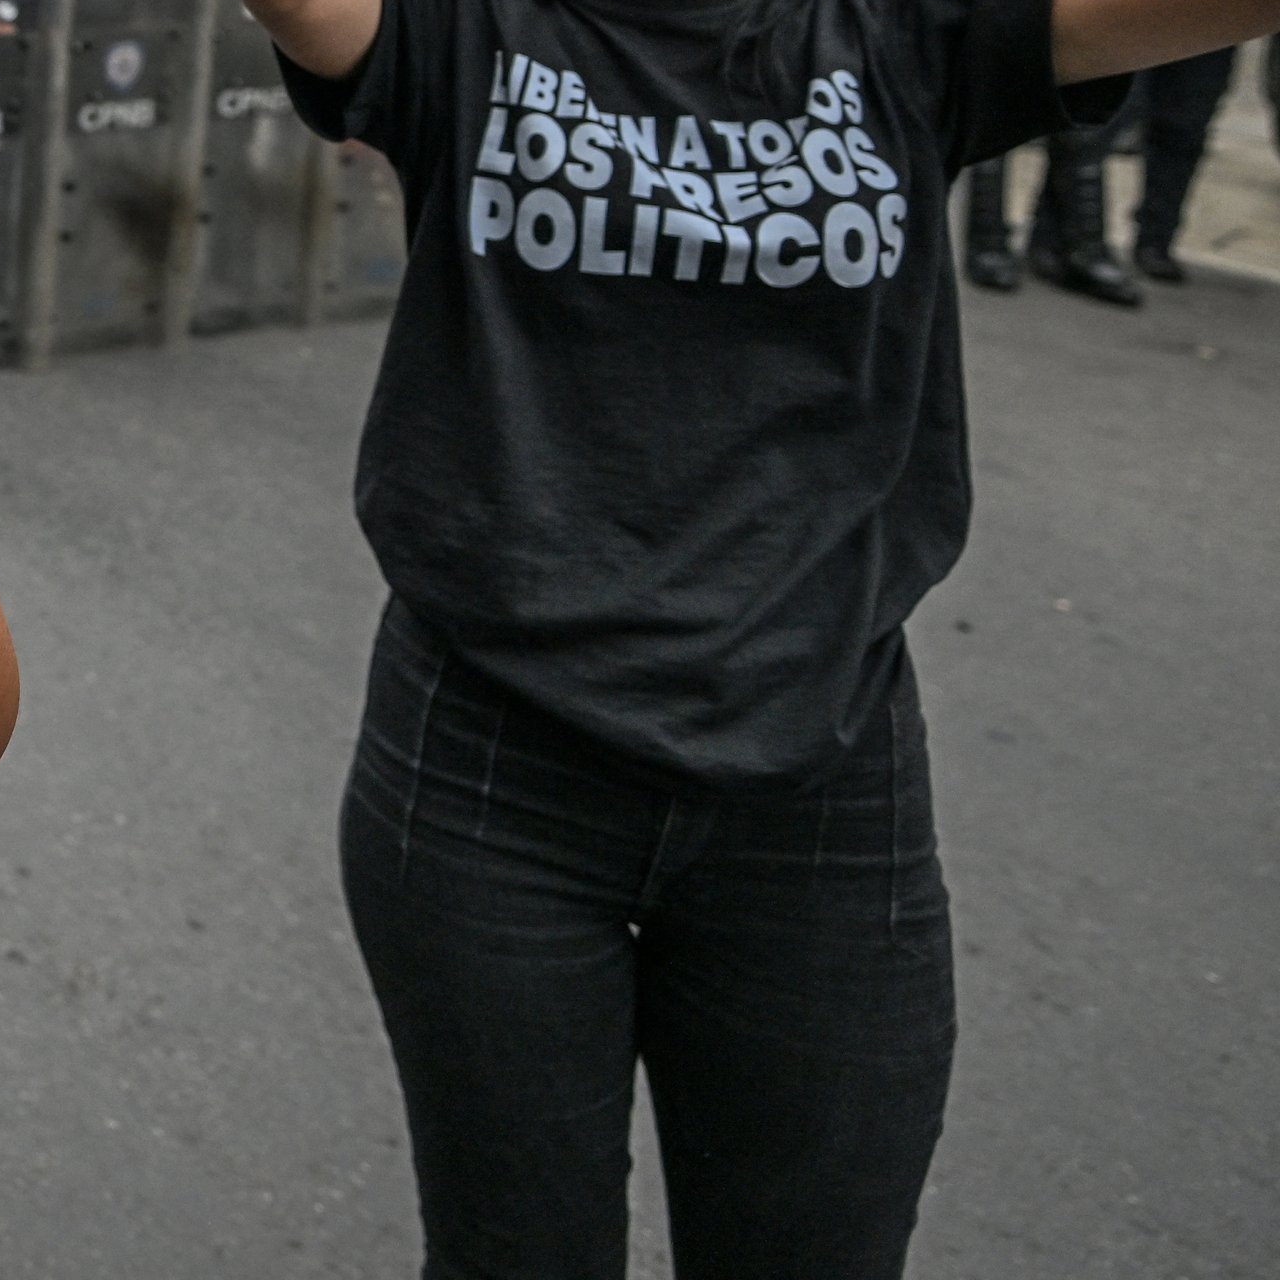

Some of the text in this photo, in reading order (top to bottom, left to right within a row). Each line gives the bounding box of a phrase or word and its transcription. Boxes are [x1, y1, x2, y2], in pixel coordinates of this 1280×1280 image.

[478, 106, 614, 191] LOS
[669, 113, 713, 171] A
[468, 175, 908, 289] POLITICOS
